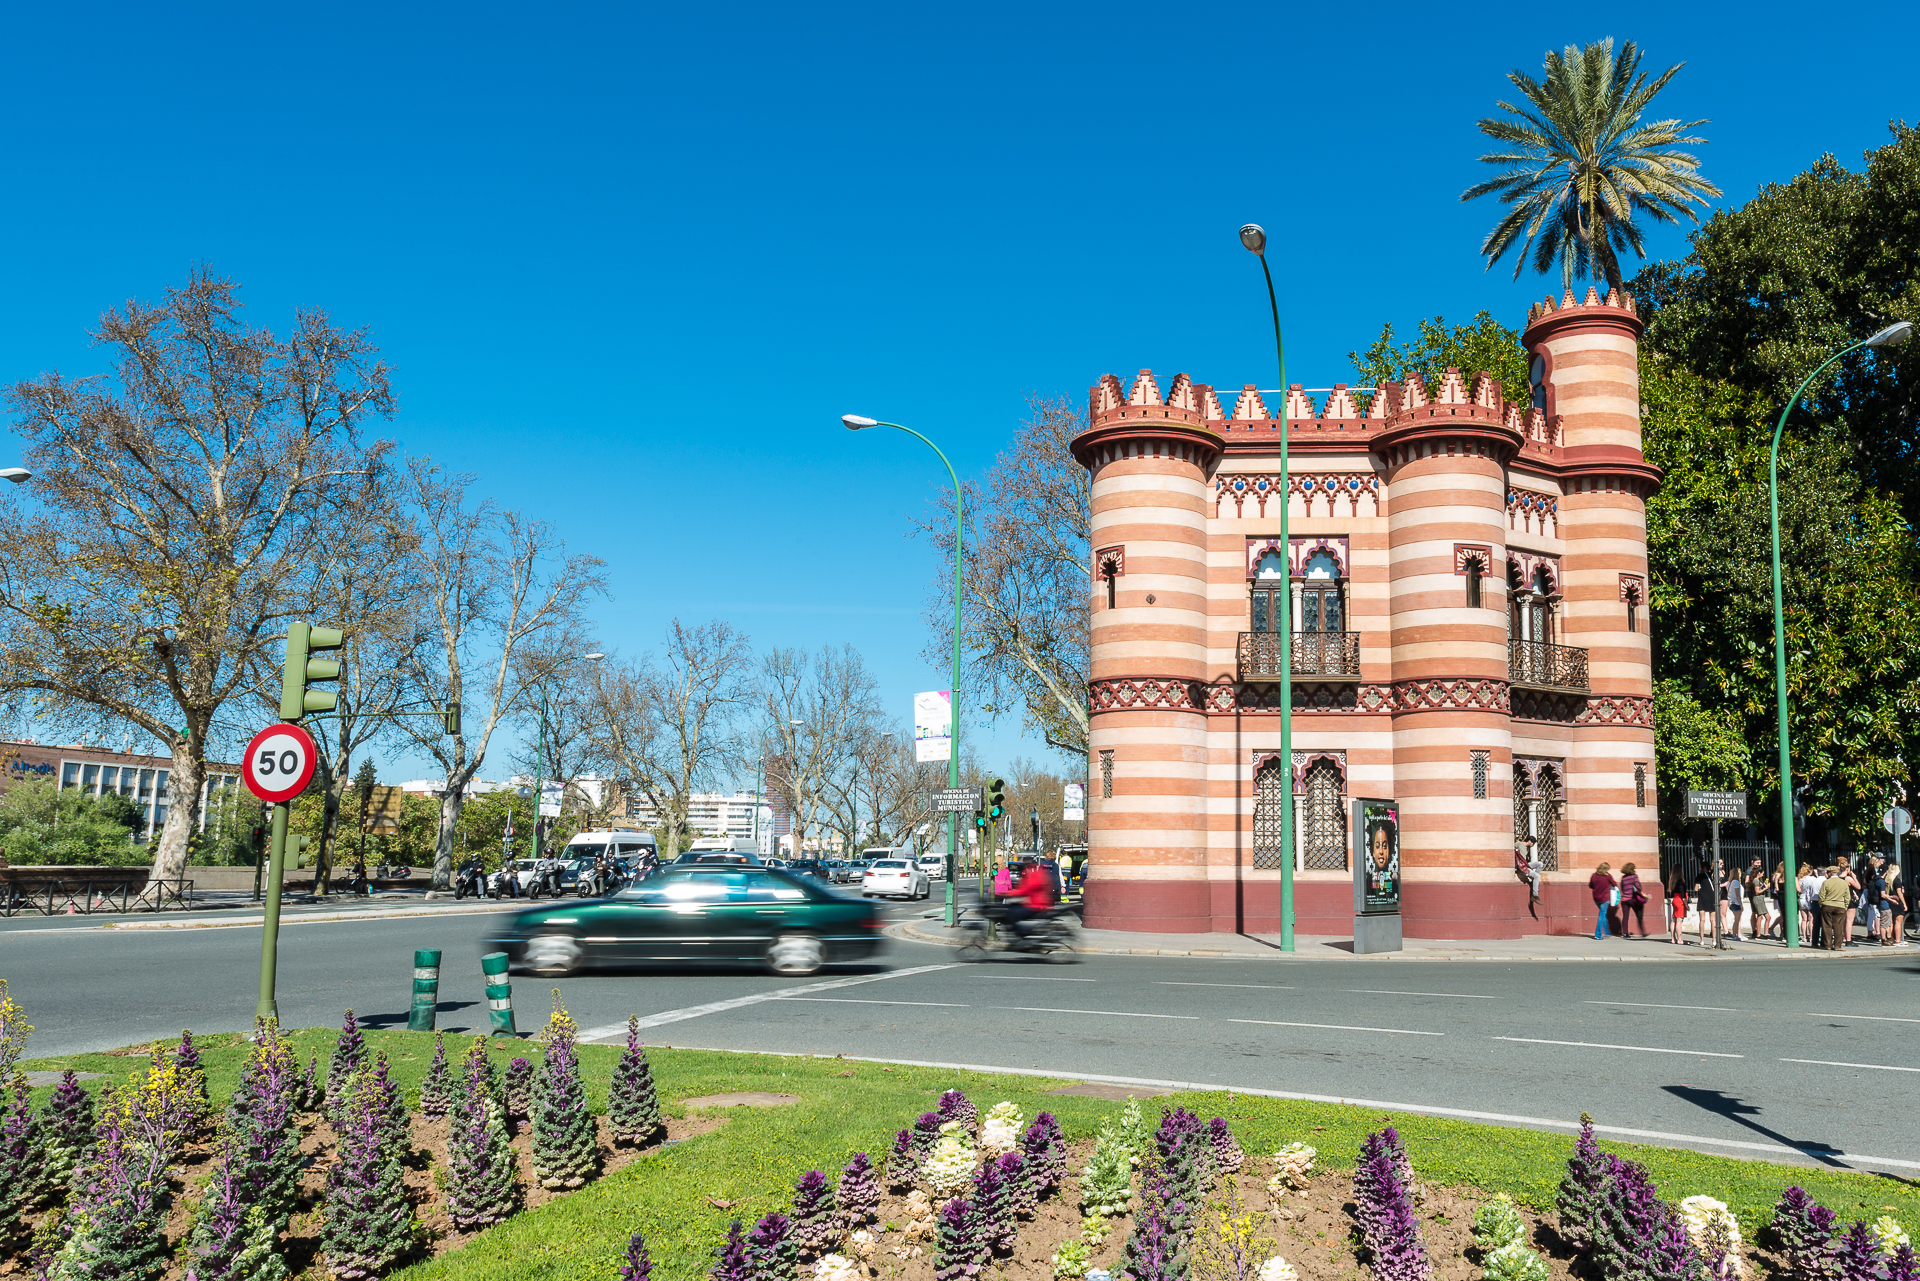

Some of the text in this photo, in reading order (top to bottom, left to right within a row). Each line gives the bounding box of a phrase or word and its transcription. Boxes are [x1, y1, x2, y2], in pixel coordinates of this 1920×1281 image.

[10, 760, 55, 773] Altadis
[258, 749, 298, 776] 50
[1690, 797, 1744, 805] INFORMACION
[1697, 803, 1738, 812] TURISTICA
[1697, 810, 1738, 818] MUNICIPAL
